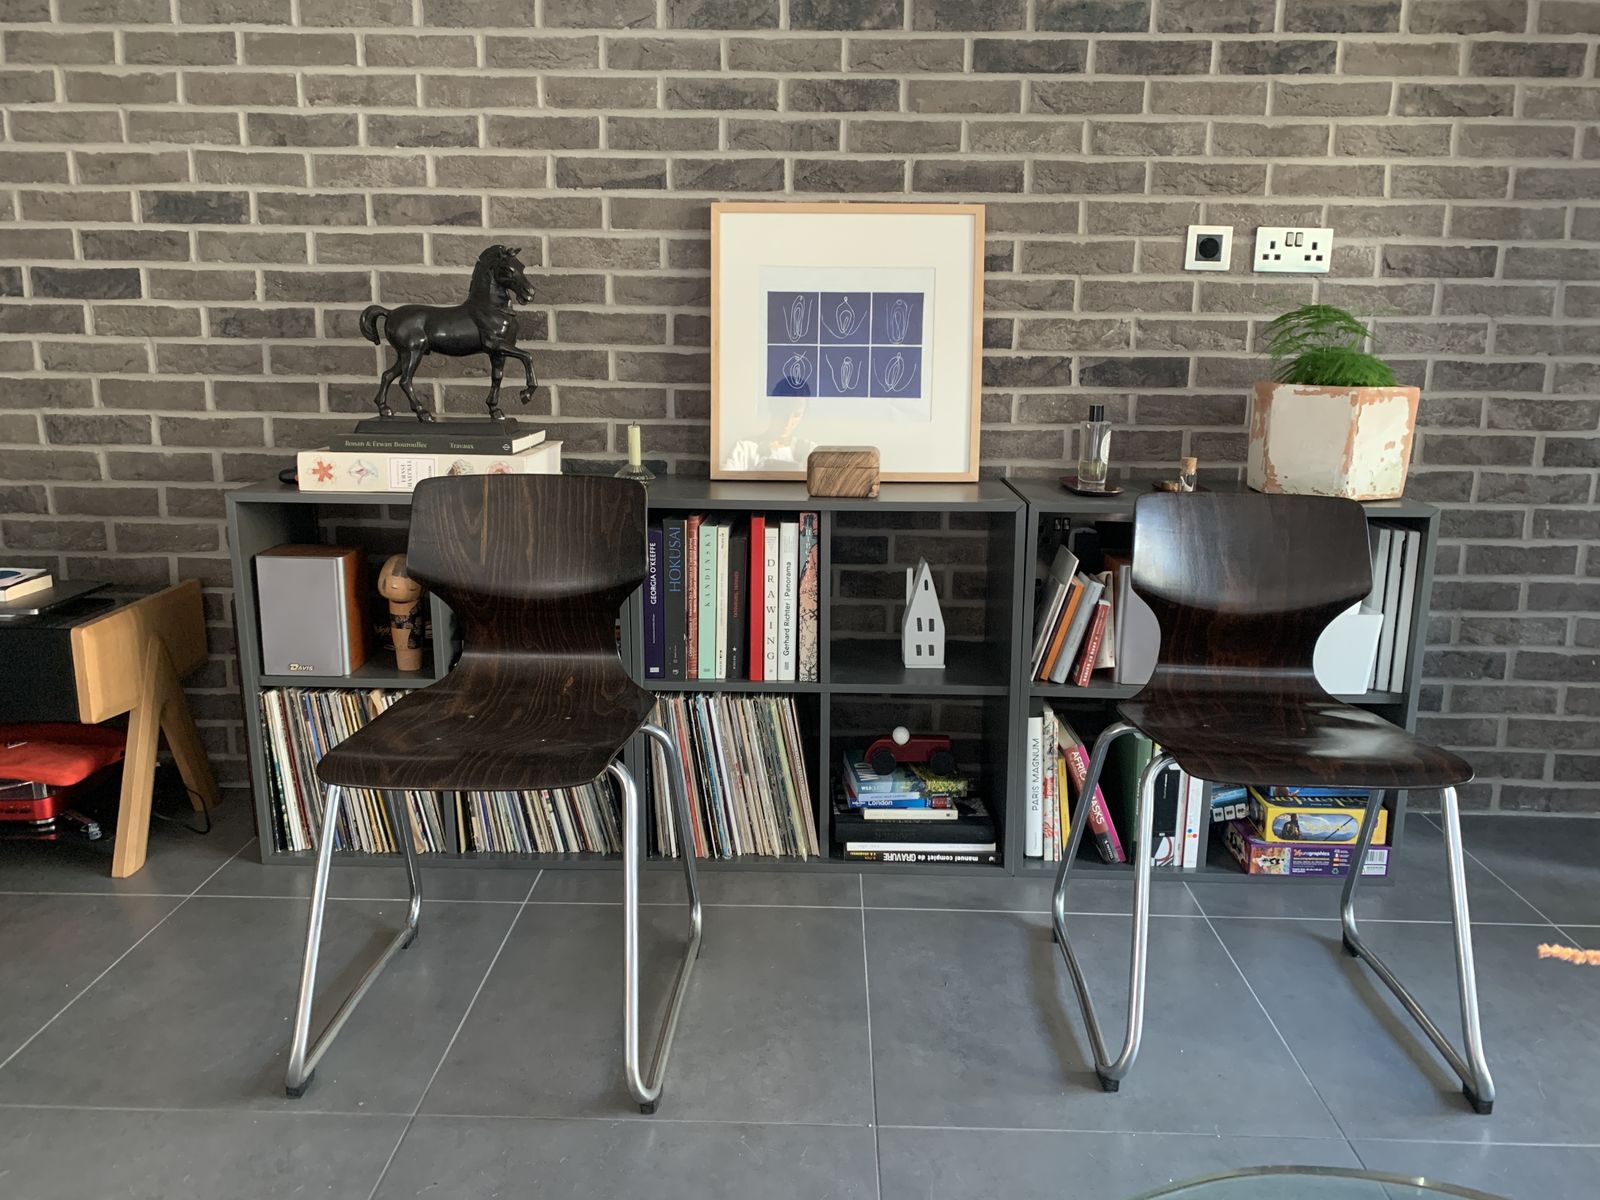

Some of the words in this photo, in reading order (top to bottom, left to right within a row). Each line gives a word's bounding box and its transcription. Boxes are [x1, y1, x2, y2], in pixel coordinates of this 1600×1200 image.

[668, 527, 681, 592] HOKUSAI
[784, 561, 792, 597] Panorama
[766, 558, 776, 660] DRAWING
[783, 602, 791, 627] Richter
[783, 627, 791, 656] Gerhard
[1032, 738, 1040, 781] MAGNUM
[1032, 784, 1040, 811] PARIS
[883, 852, 917, 862] GRAVURE
[927, 854, 954, 862] complet
